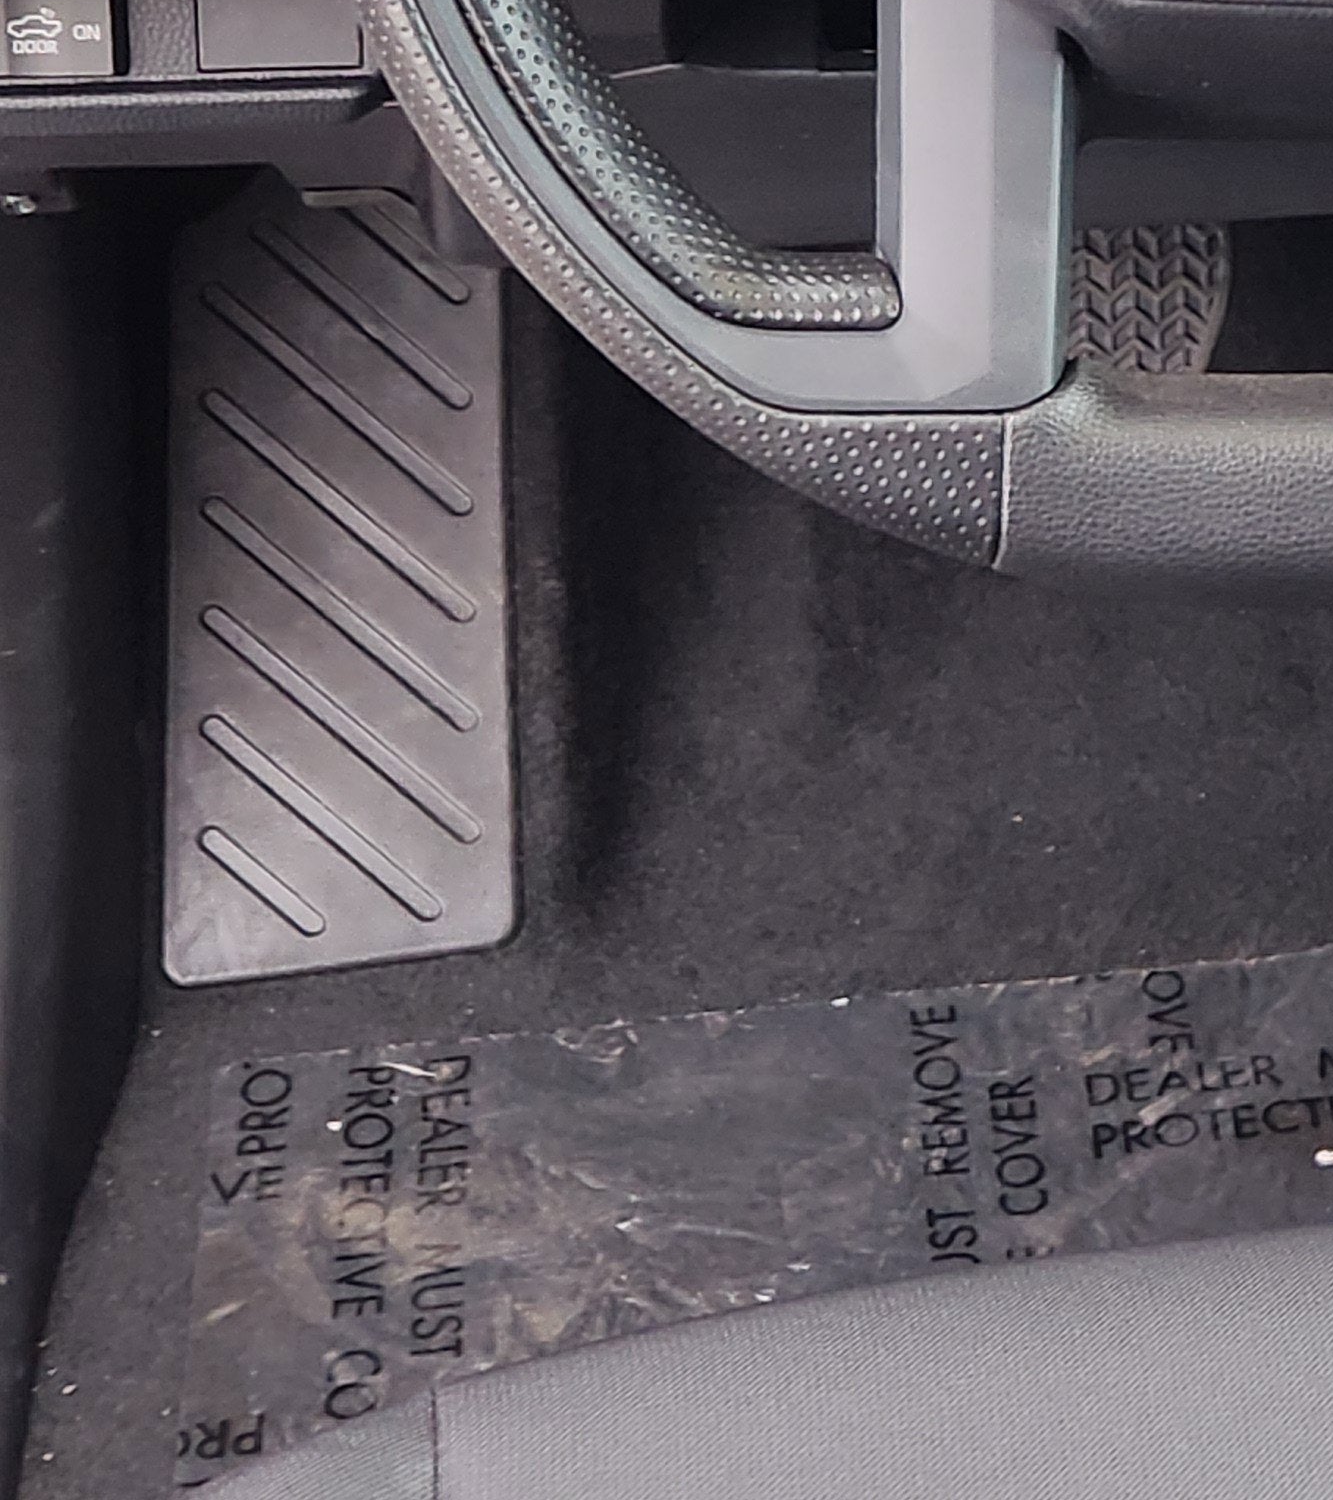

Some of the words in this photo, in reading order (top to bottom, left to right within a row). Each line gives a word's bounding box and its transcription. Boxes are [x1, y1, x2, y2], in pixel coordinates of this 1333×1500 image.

[12, 39, 59, 54] DOOR
[73, 23, 101, 42] ON
[413, 1054, 472, 1216] DEALER
[908, 1004, 971, 1177] REMOVE
[1084, 1054, 1284, 1107] DEALER
[331, 1065, 397, 1321] PROTECTIVE
[986, 1074, 1050, 1217] COVER
[409, 1243, 466, 1359] MUST
